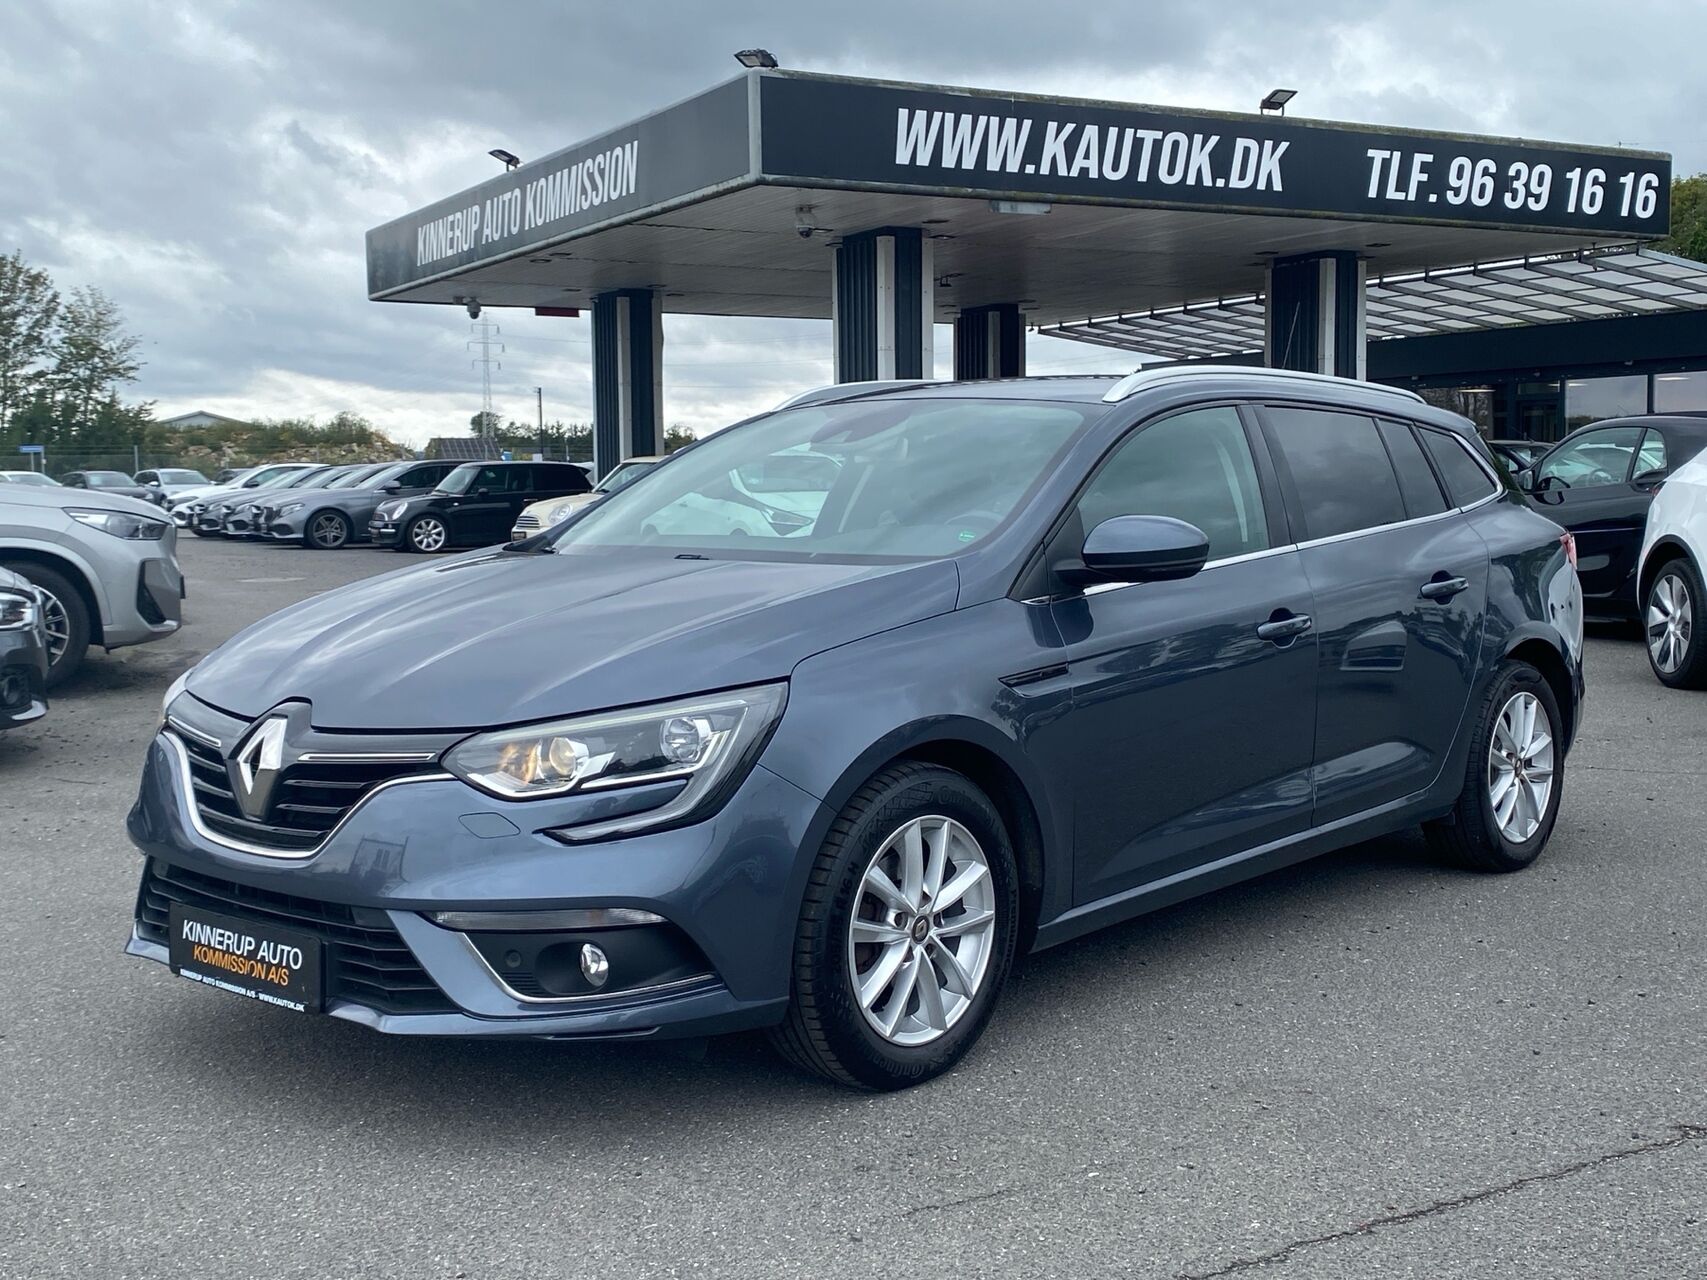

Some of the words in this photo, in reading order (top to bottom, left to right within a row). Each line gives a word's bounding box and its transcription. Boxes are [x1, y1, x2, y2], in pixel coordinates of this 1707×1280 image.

[417, 204, 480, 267] KINNERUP
[481, 187, 521, 245] AUTO
[525, 140, 638, 231] KOMMISSION
[896, 108, 1290, 192] WWW.KAUTOK.DK
[1367, 148, 1437, 203] TLF.
[1446, 155, 1497, 207] 96
[1503, 161, 1553, 212] 39
[1565, 167, 1606, 215] 16
[1619, 171, 1659, 219] 16
[182, 919, 255, 957] KINNERUP
[257, 940, 303, 970] AUTO
[193, 945, 266, 980] KOMMISSION
[267, 967, 289, 986] A/S
